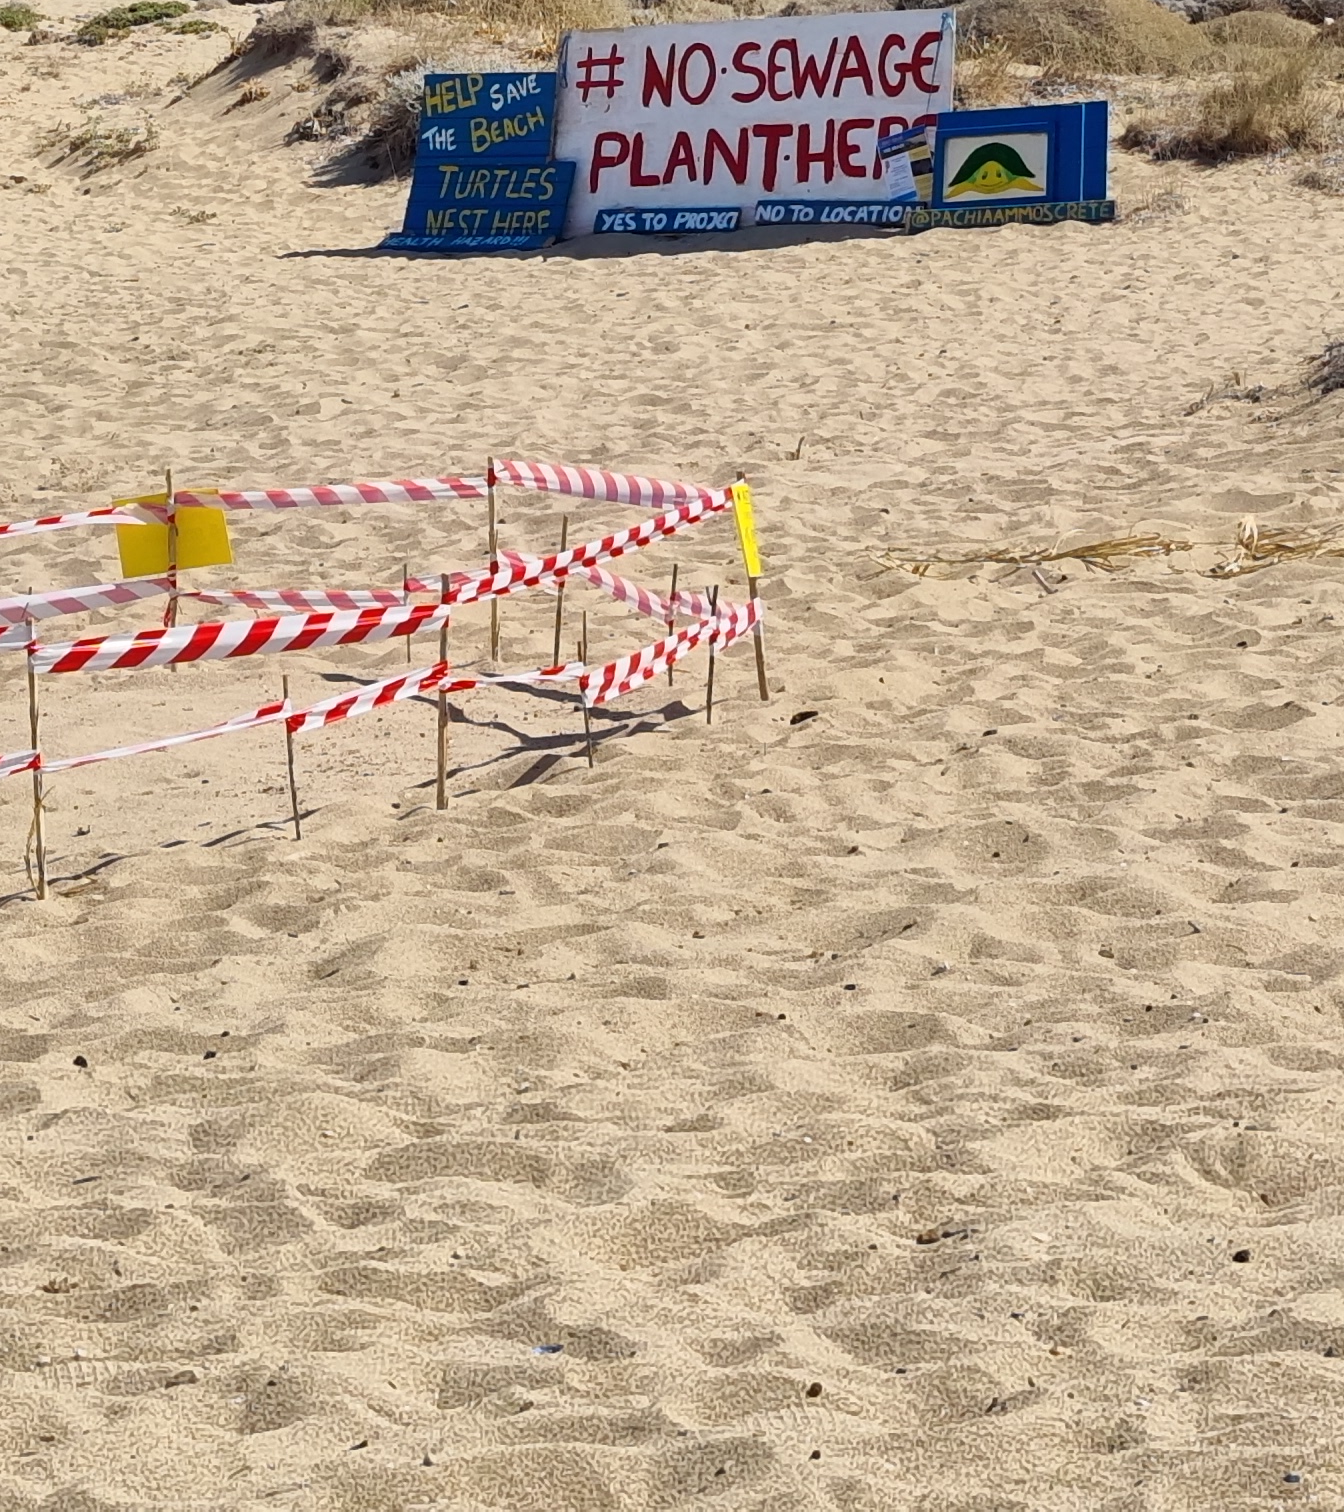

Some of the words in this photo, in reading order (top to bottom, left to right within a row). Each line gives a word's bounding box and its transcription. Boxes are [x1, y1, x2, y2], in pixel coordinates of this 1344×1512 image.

[424, 73, 484, 118] HELP
[489, 74, 542, 112] SAVE
[421, 126, 458, 151] THE
[470, 105, 545, 154] BEACH
[438, 164, 557, 202] TURTLES
[425, 208, 489, 237] NEST
[491, 209, 551, 237] HERE
[601, 212, 637, 232] YES
[641, 212, 668, 231] TO
[755, 200, 785, 223] NO
[788, 204, 814, 223] TO
[910, 202, 1111, 227] @PACHIAAMMOSCRETE
[385, 236, 445, 249] HEALTH
